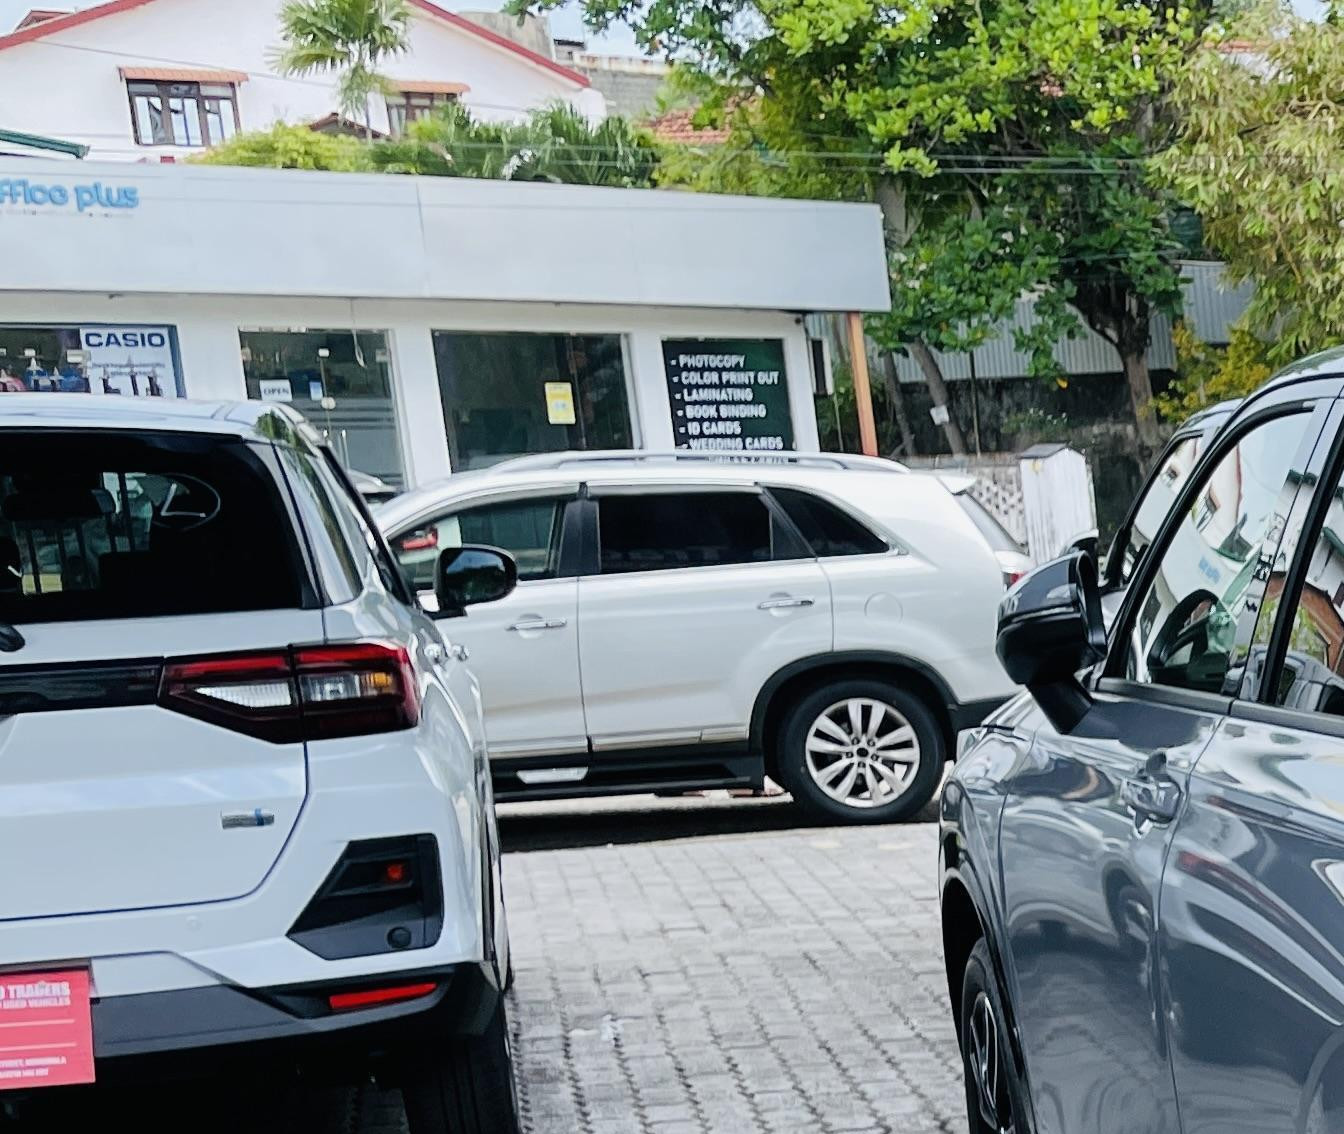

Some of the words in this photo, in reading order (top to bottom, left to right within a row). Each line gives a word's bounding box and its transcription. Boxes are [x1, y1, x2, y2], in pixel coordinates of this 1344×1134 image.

[75, 181, 140, 213] plus
[85, 332, 166, 348] CASIO
[679, 354, 746, 369] PHOTOCOPY
[681, 371, 720, 385] COLOR
[722, 371, 755, 385] PRINT
[757, 371, 780, 385] OUT
[683, 388, 754, 402] LAMINATING
[685, 404, 718, 419] BOOK
[719, 404, 767, 418] BINDING
[687, 421, 701, 436] ID
[702, 420, 742, 435] CARDS
[689, 437, 744, 451] WEDDING
[745, 436, 784, 450] CARDS
